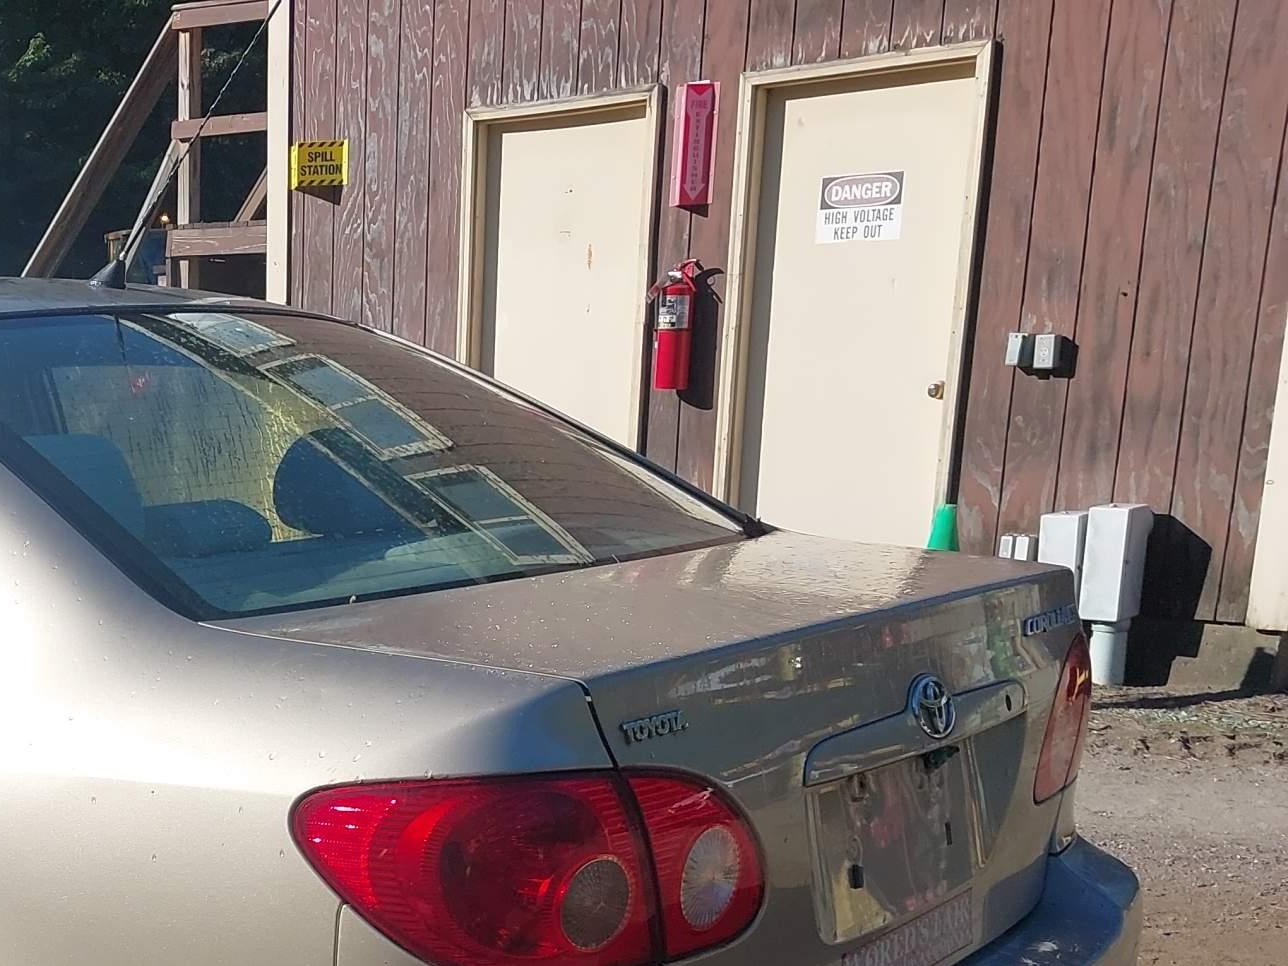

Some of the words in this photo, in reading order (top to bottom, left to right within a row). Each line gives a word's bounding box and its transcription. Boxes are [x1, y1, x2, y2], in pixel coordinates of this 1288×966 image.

[307, 151, 336, 163] SPILL
[300, 164, 342, 176] STATION
[831, 181, 892, 202] DANGER
[824, 211, 848, 225] HIGH
[853, 207, 895, 223] VOLTAGE
[833, 226, 858, 240] KEEP
[863, 224, 883, 239] OUT
